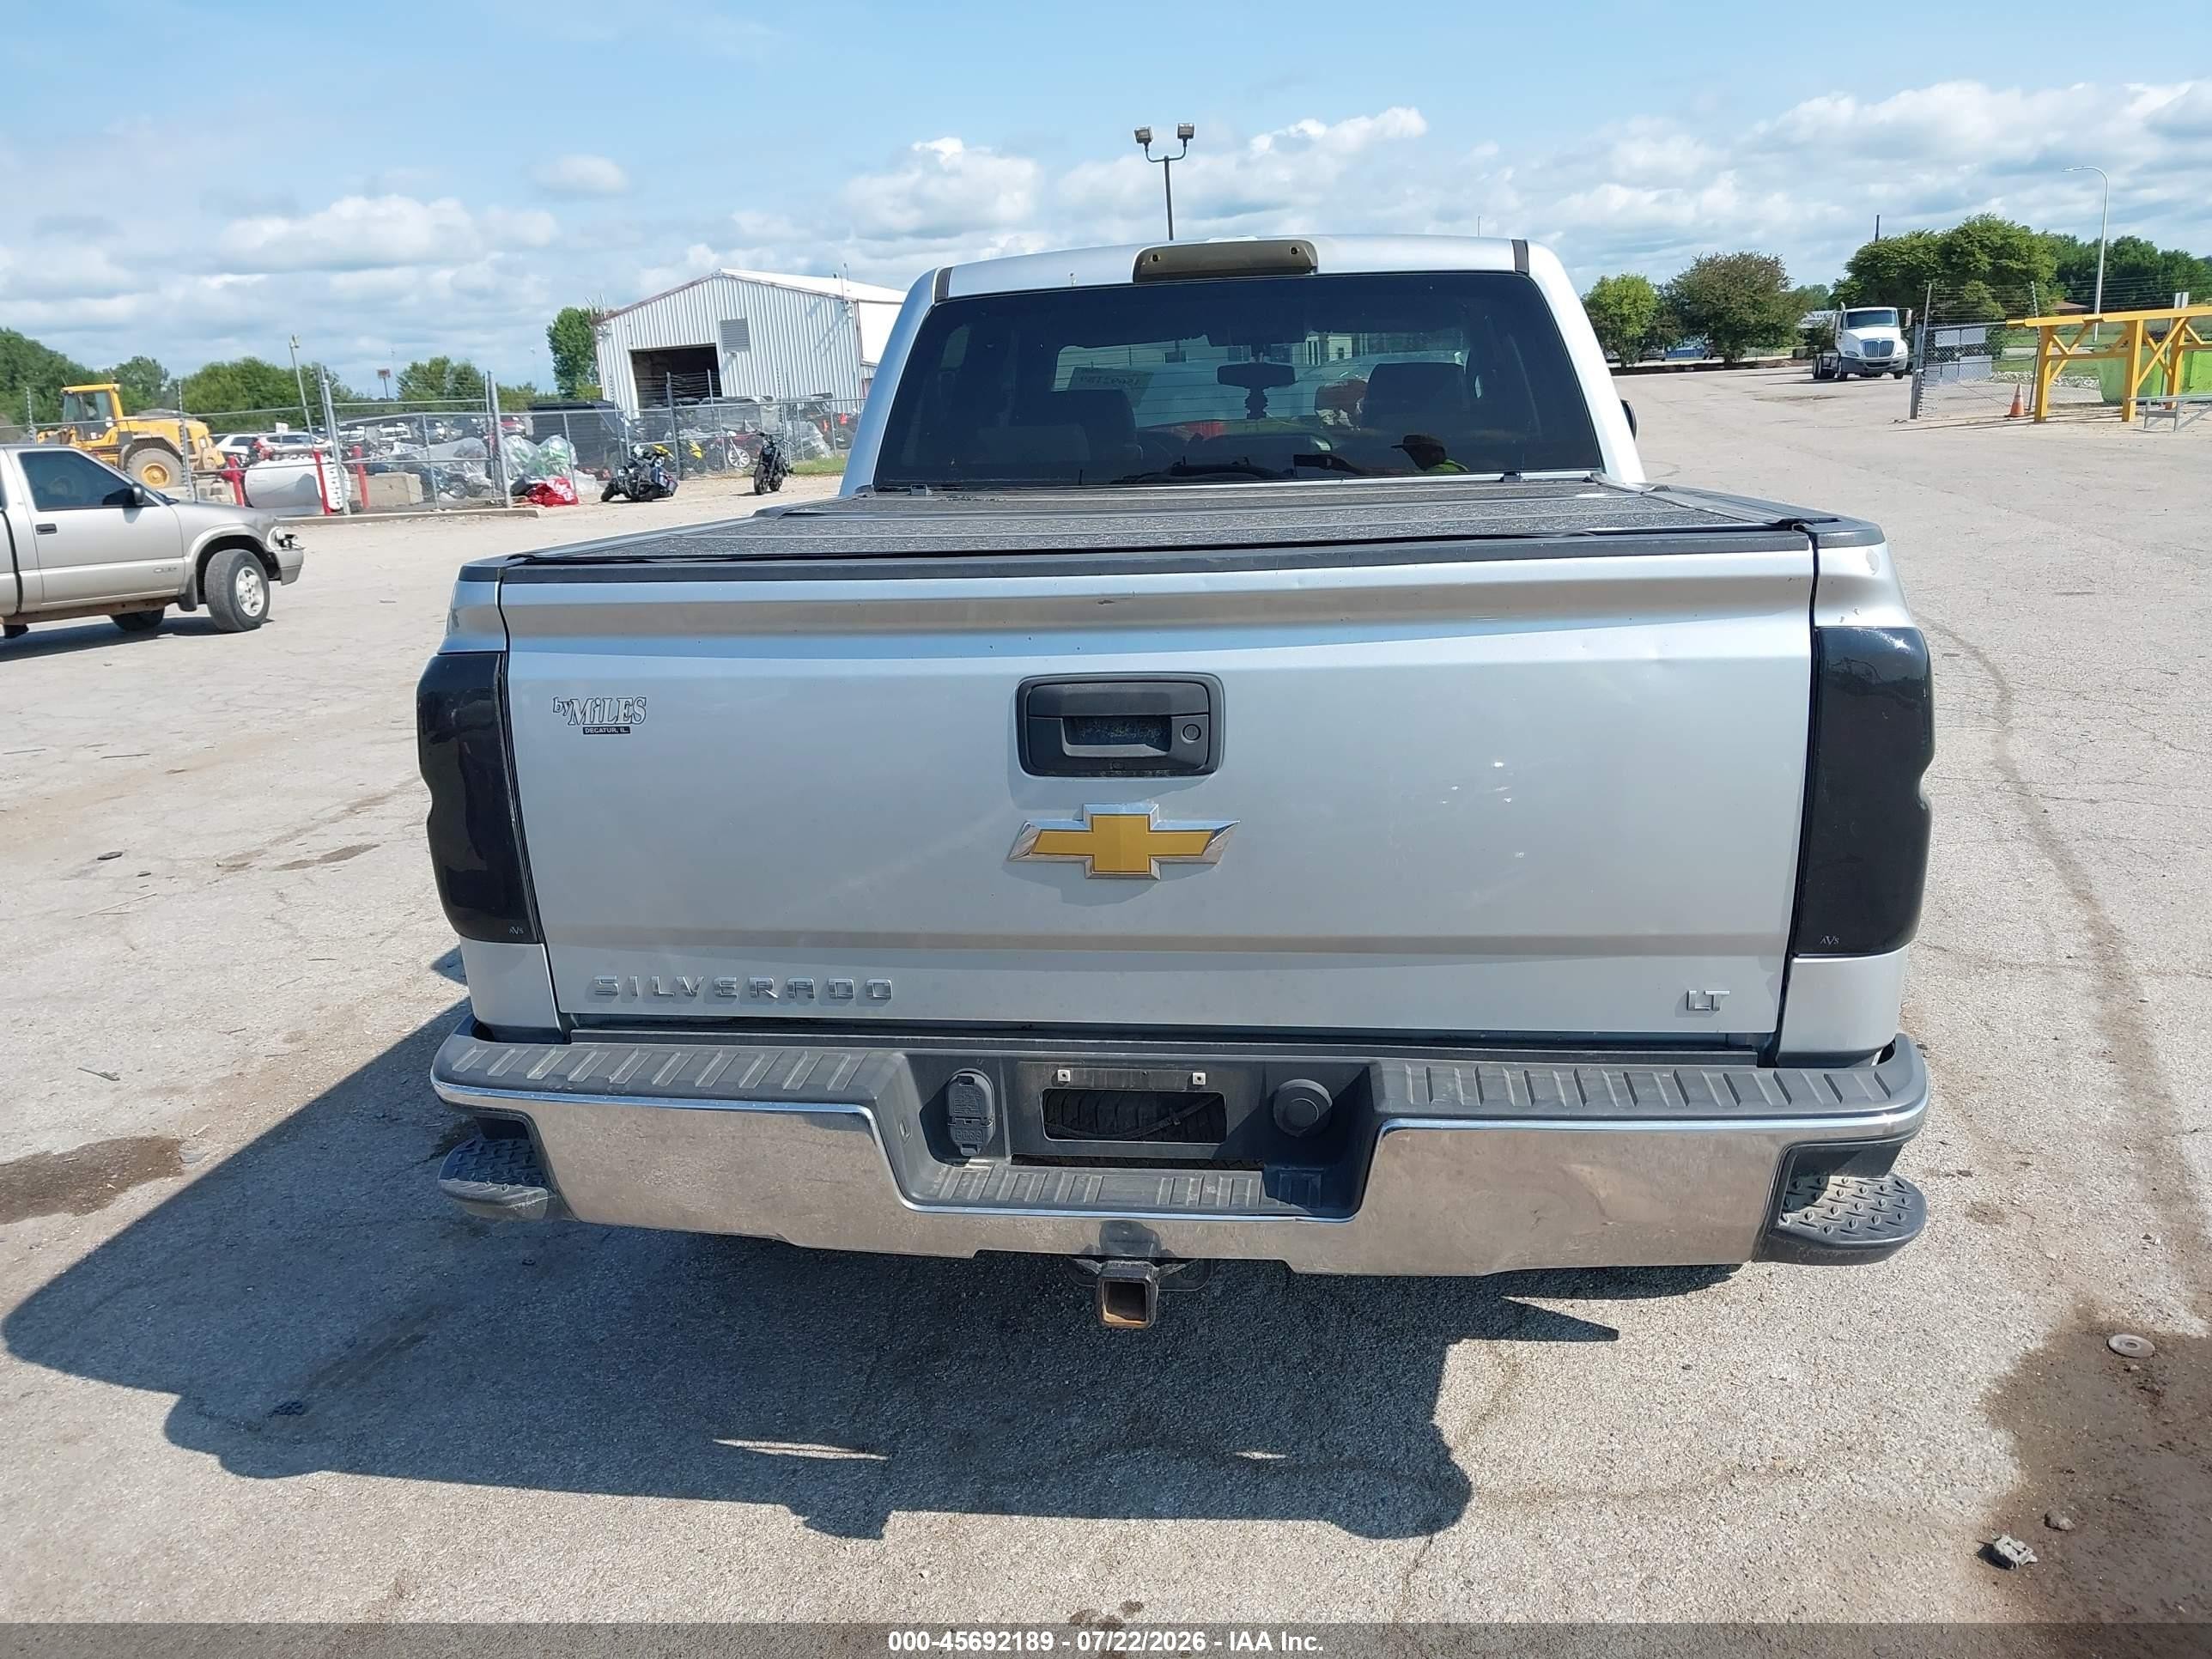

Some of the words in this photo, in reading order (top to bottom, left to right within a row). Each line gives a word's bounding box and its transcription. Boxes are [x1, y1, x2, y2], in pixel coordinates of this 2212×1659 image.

[1820, 936, 1839, 946] AVS
[594, 975, 893, 1000] SILVERADO
[1686, 990, 1730, 1011] LT
